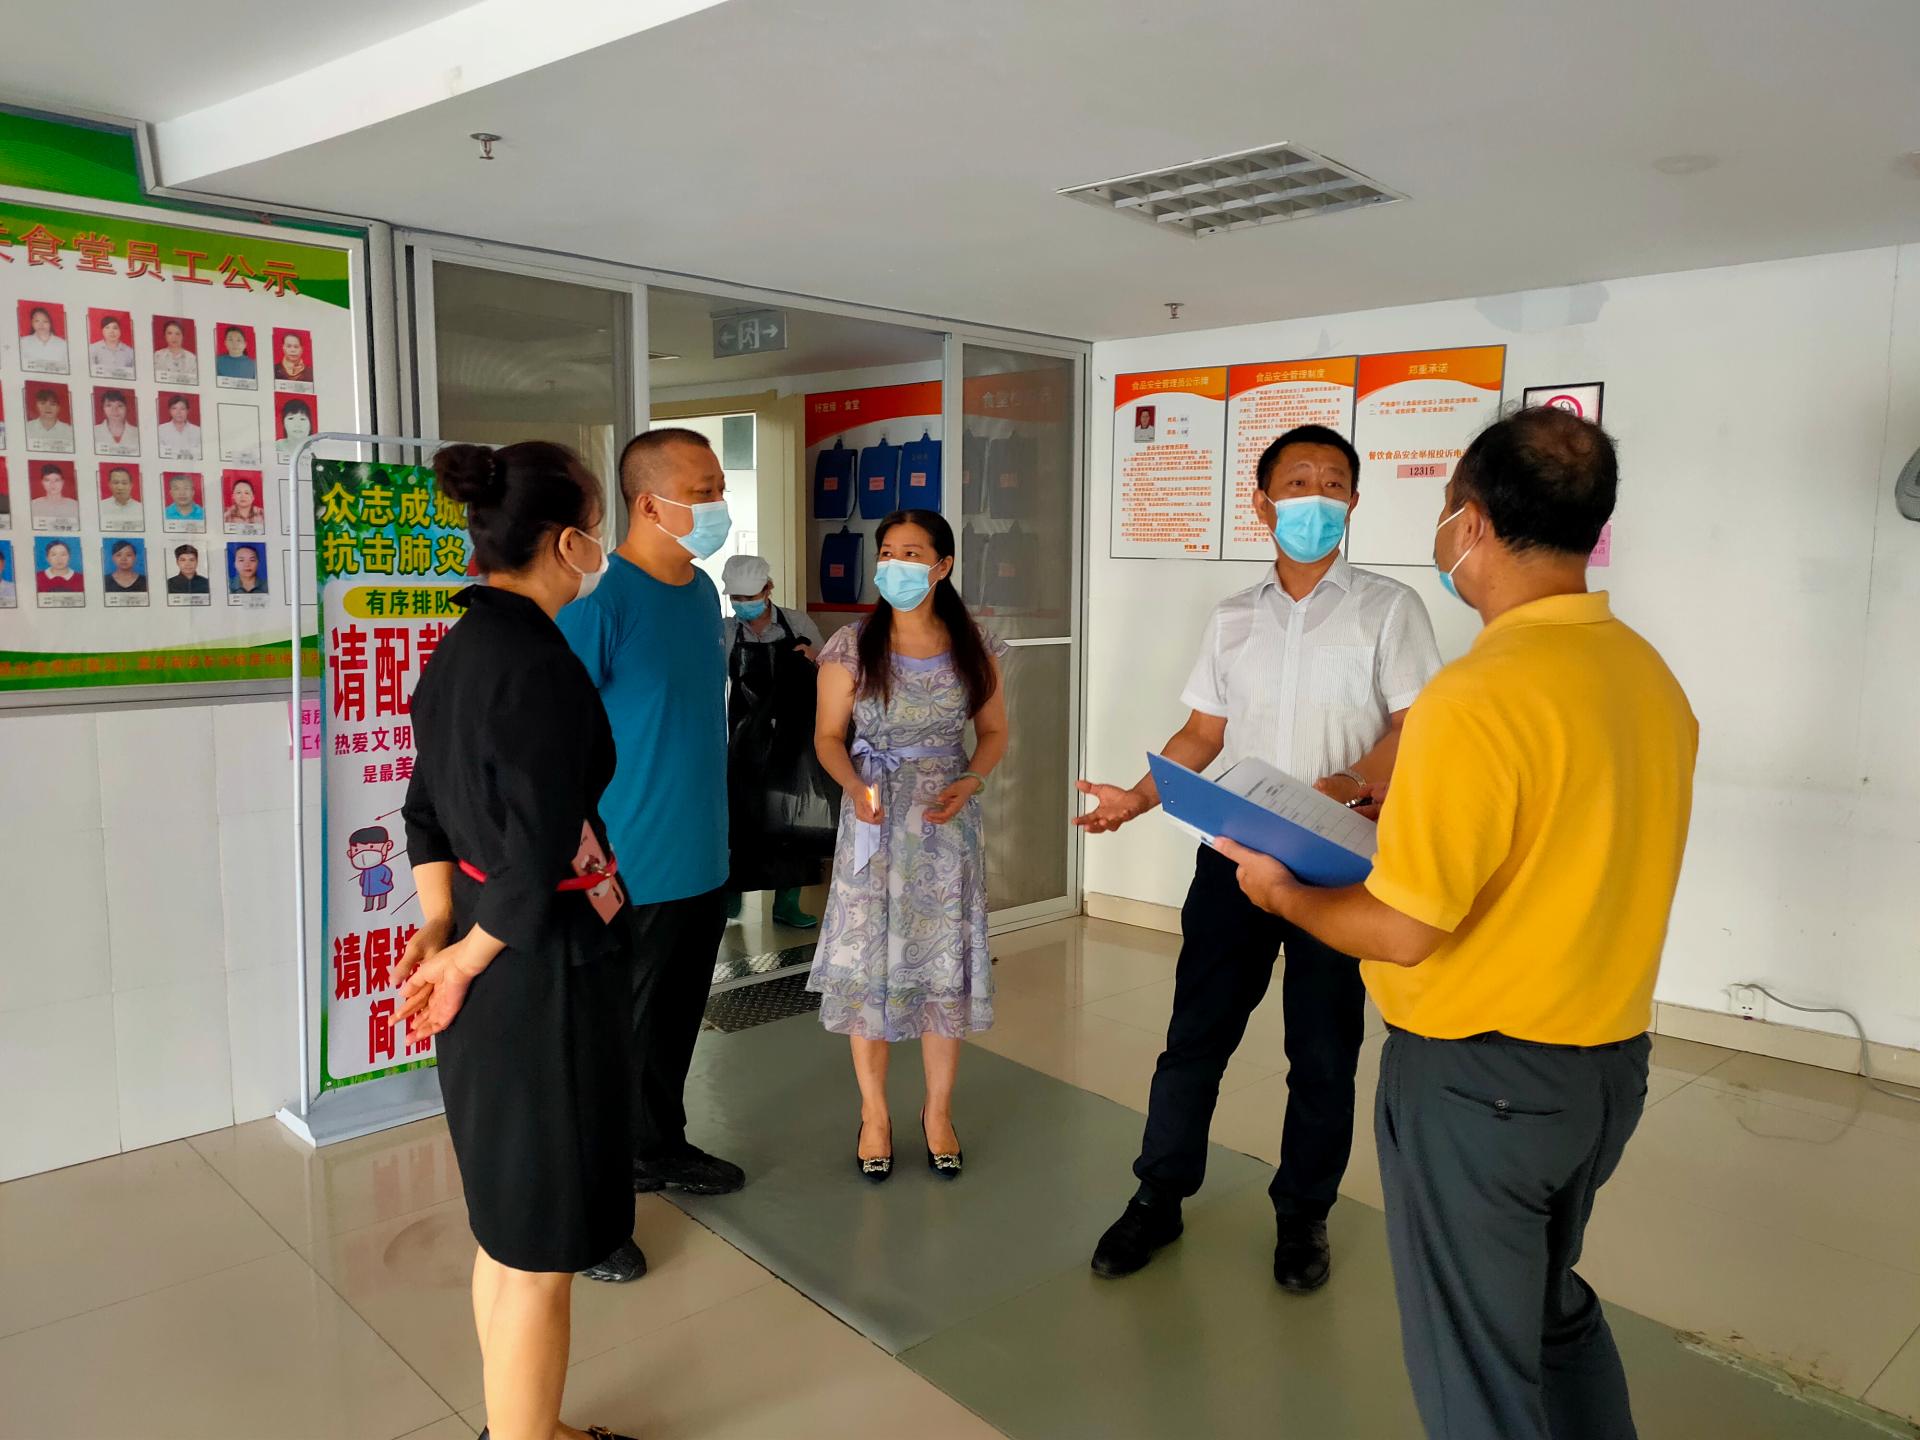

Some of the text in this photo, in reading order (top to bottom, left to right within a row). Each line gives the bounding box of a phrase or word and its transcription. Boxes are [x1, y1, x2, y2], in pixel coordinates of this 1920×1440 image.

[1410, 466, 1435, 476] 12315
[321, 482, 468, 529] 众志成城
[322, 534, 468, 576] 抗击肺炎
[366, 589, 467, 615] 有序排队
[335, 726, 416, 755] 热爱文明
[363, 756, 413, 784] 是最美
